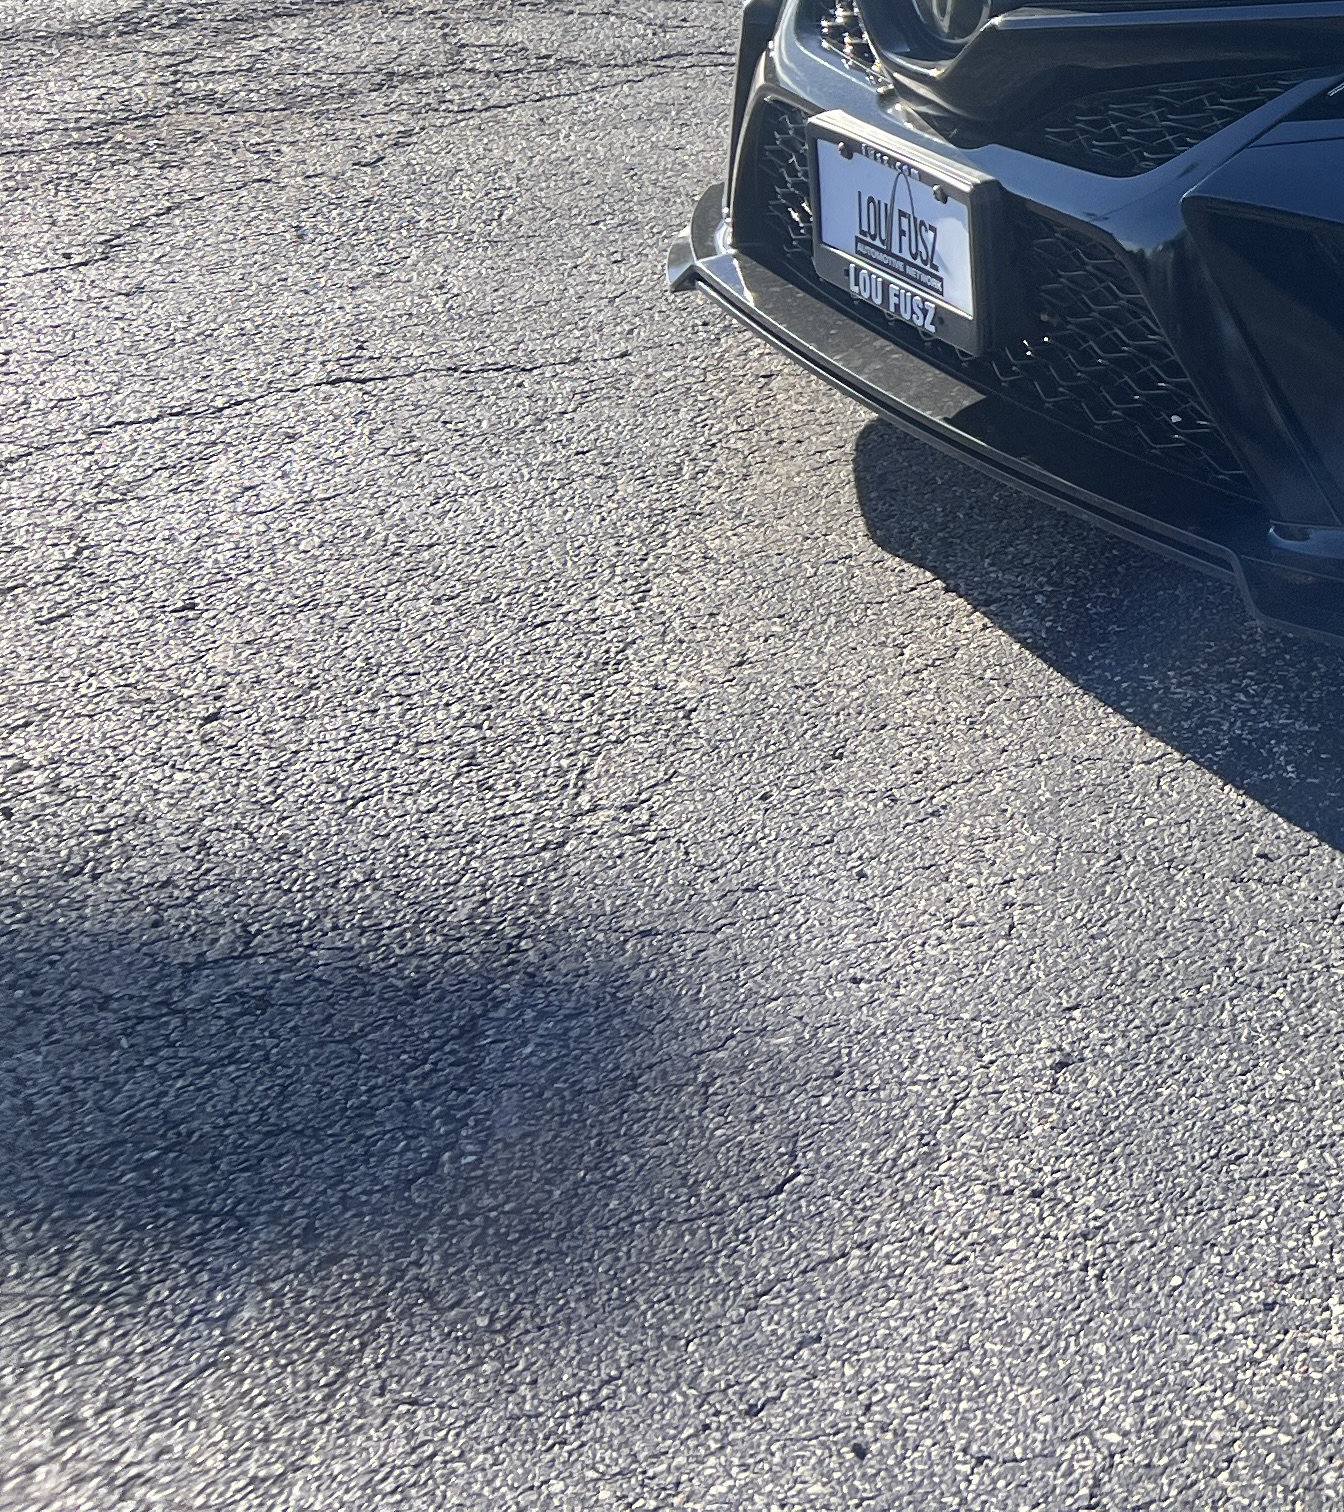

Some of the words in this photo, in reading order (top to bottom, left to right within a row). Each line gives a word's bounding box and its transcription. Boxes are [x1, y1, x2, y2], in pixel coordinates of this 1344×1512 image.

[858, 190, 889, 247] LOU
[898, 208, 939, 272] FUSZ
[849, 263, 883, 305] LOU
[889, 283, 936, 333] FUSZ
